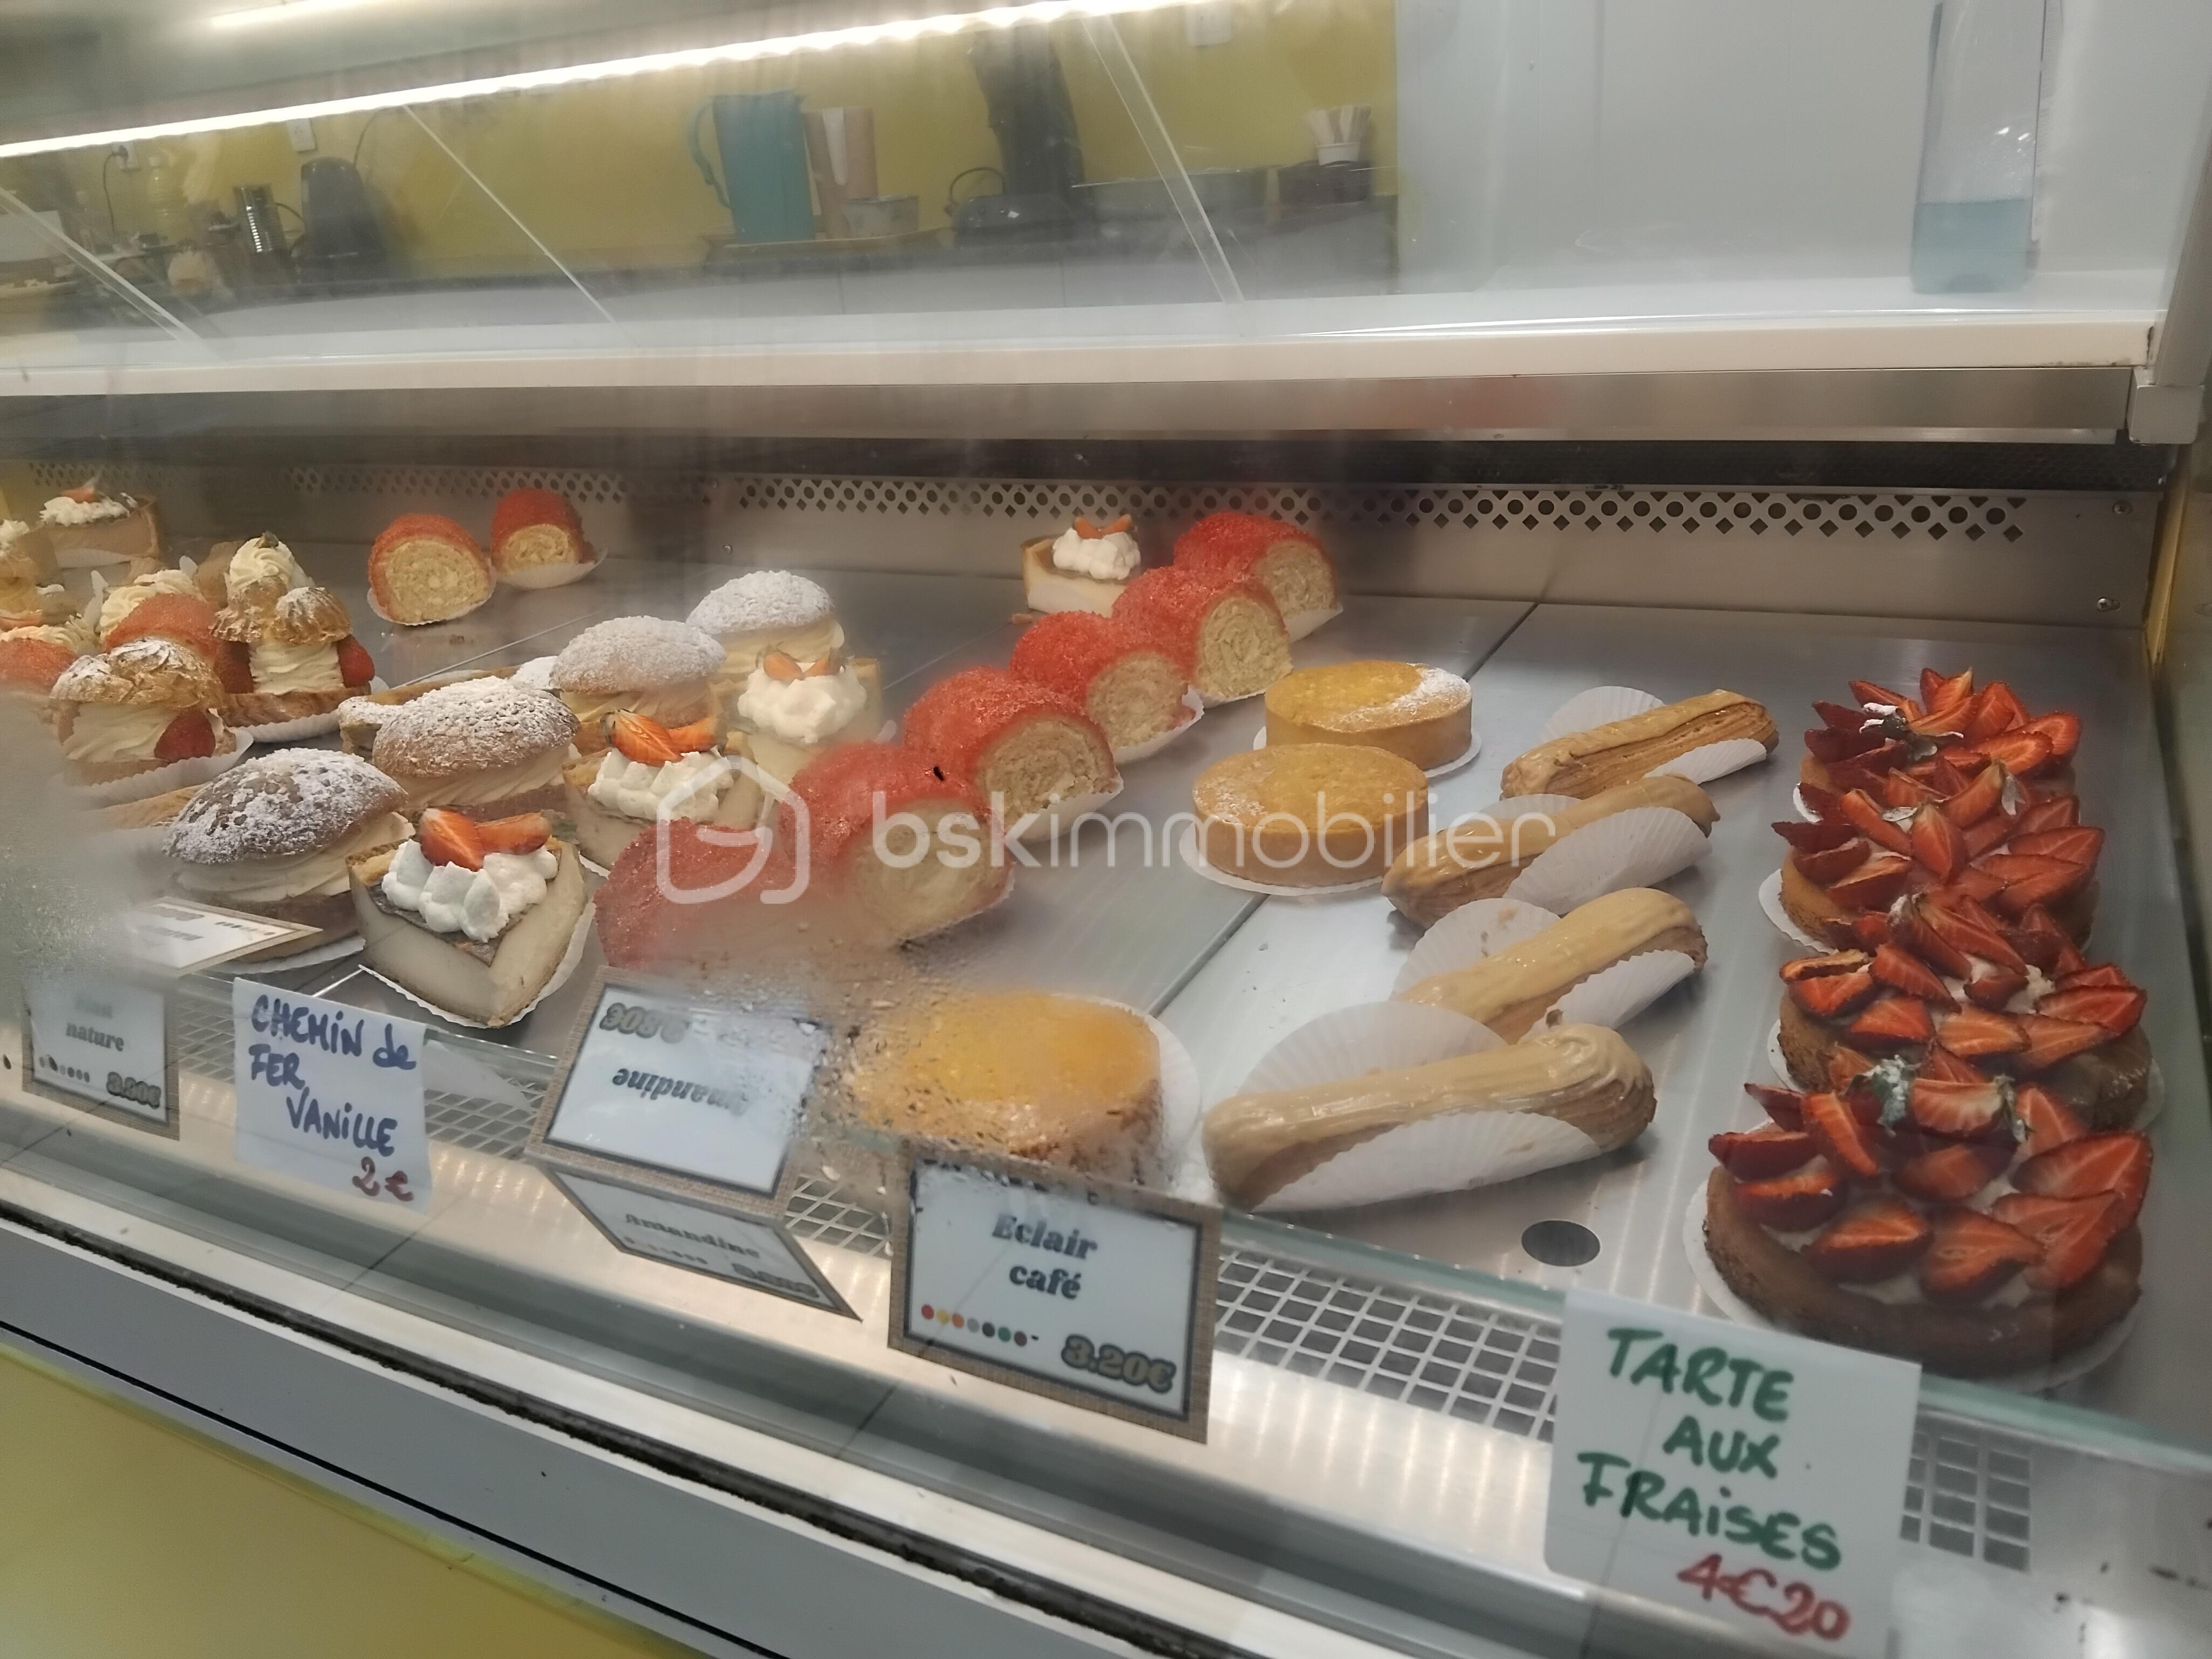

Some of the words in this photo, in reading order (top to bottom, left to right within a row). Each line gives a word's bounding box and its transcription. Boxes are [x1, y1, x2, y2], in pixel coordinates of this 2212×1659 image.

[65, 1022, 124, 1051] nature
[372, 1023, 416, 1070] de
[248, 1043, 306, 1090] FER
[625, 1212, 760, 1259] Amandine
[991, 1212, 1098, 1260] Eclair
[1009, 1264, 1082, 1300] café
[1061, 1333, 1177, 1394] 3.20€
[1607, 1327, 1794, 1422] TARTE
[1663, 1415, 1781, 1479] AUX
[1677, 1553, 1851, 1641] 4€20
